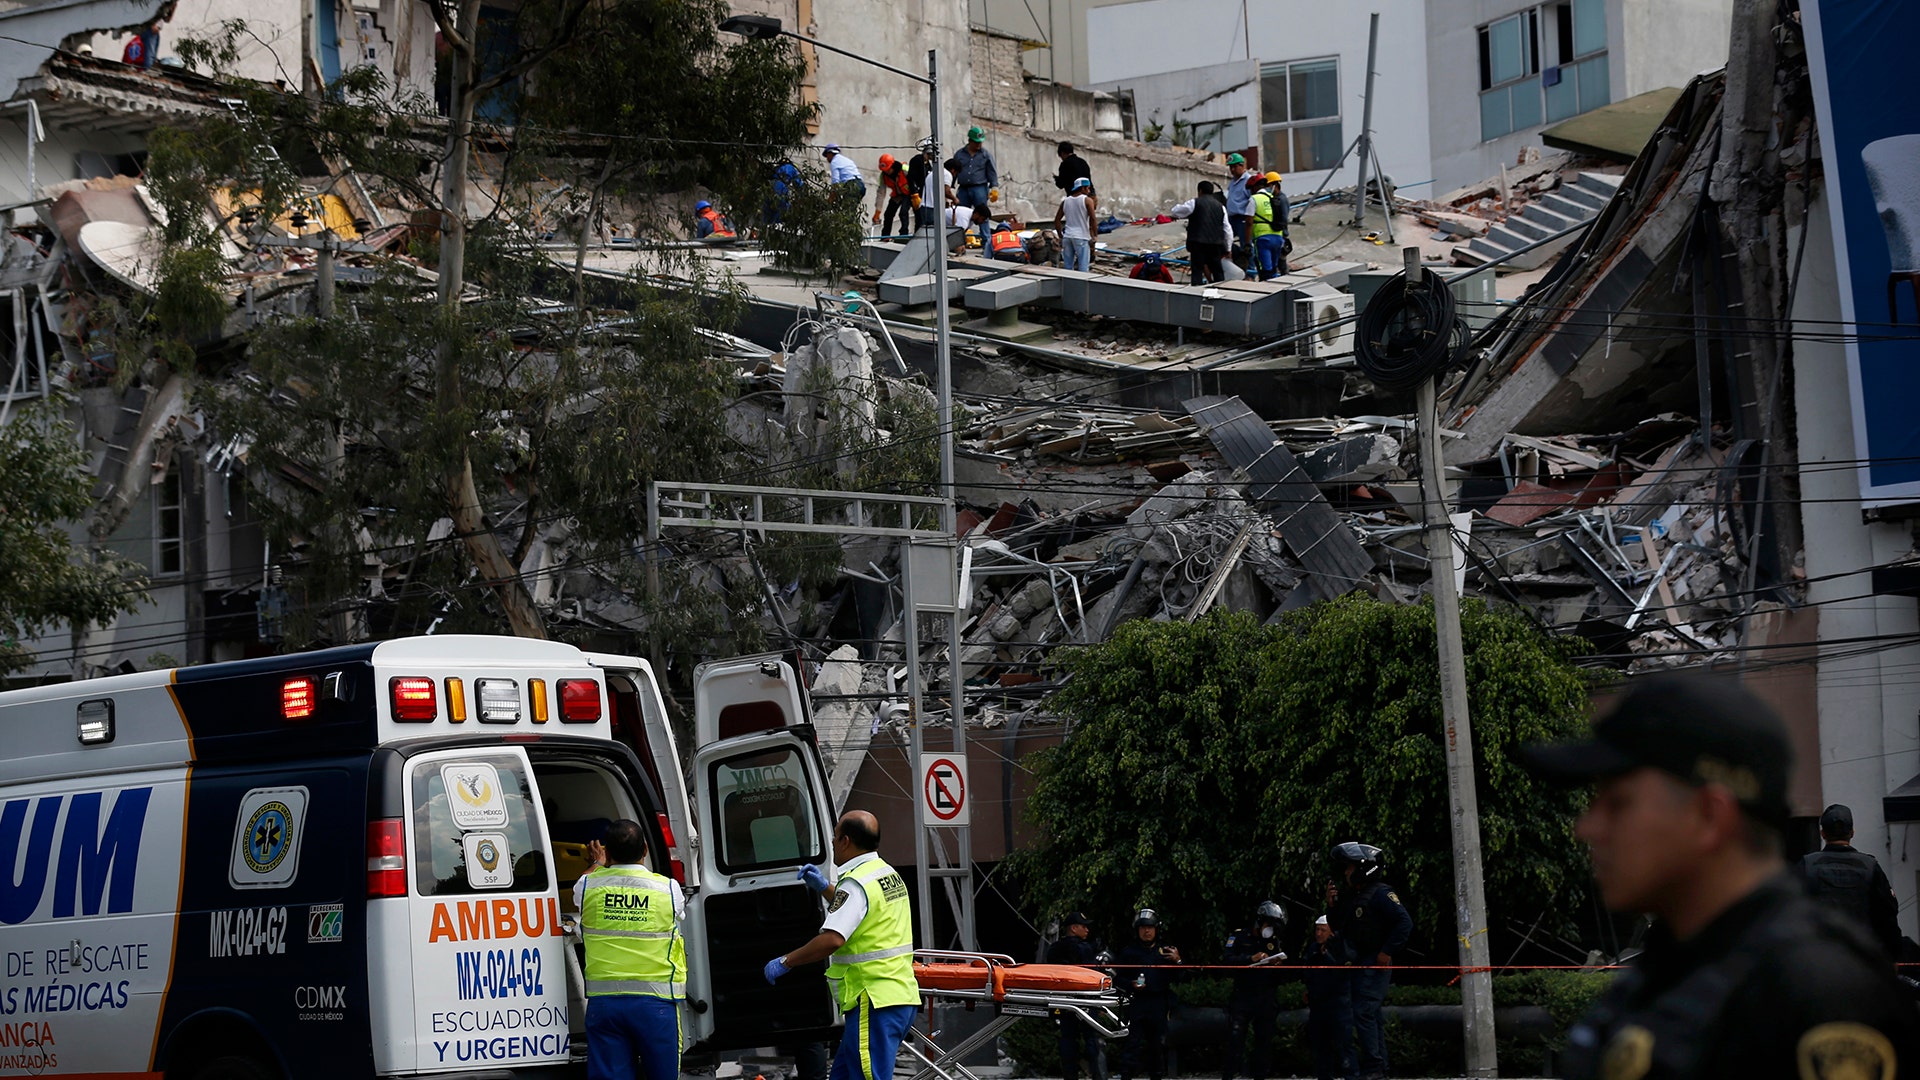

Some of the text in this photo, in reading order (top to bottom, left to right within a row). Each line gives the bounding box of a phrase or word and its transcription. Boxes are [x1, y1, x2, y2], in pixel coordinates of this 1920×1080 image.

[0, 787, 153, 925] UM
[604, 893, 649, 909] ERUM
[210, 907, 287, 957] MX-024-G2
[309, 911, 342, 938] 066
[429, 897, 564, 943] AMBUL
[7, 951, 34, 977] DE
[456, 948, 543, 1000] MX-024-G2
[24, 978, 130, 1013] MÉDICAS
[295, 986, 346, 1009] CDMX
[432, 1002, 568, 1033] ESCUADRÓN
[433, 1040, 450, 1062] Y
